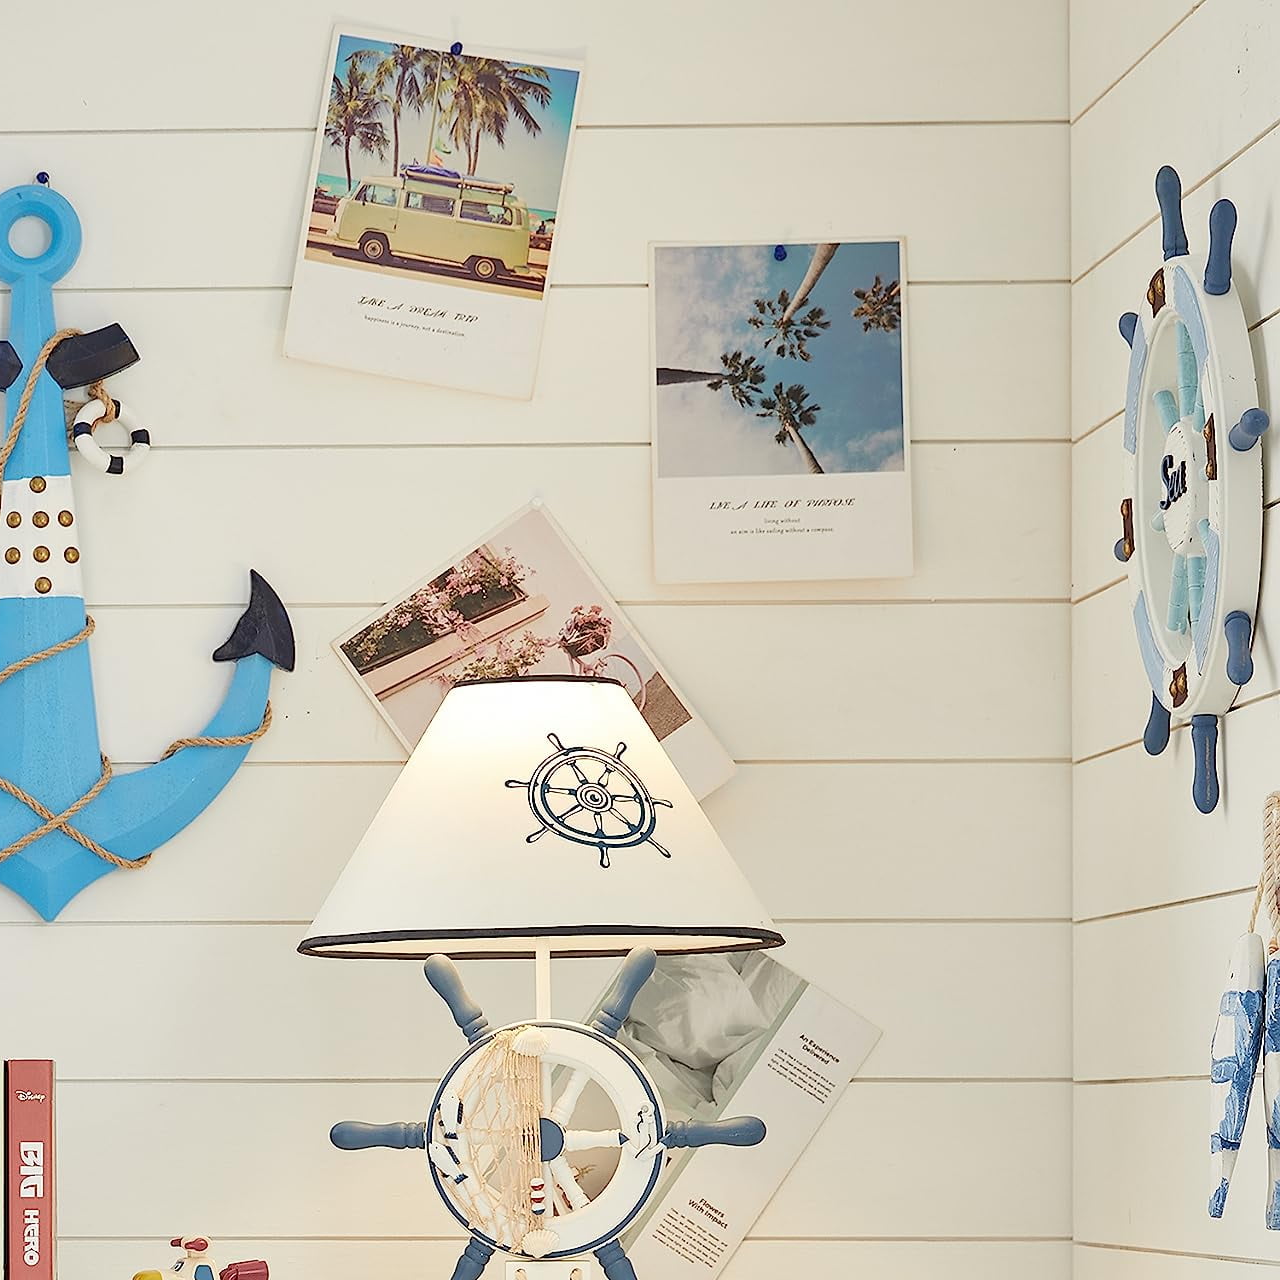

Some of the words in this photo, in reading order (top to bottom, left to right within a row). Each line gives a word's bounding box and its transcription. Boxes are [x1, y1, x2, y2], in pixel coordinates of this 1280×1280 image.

[454, 313, 479, 323] TRIP
[1160, 454, 1187, 510] Sea
[753, 500, 778, 509] LIFE
[784, 499, 802, 508] OF
[800, 1034, 809, 1042] An
[808, 1040, 840, 1063] Experience
[802, 1044, 830, 1064] Delivered
[15, 1090, 46, 1104] Disney
[20, 1142, 44, 1198] BIG
[689, 1199, 705, 1214] With
[704, 1211, 728, 1229] Impact
[699, 1198, 725, 1218] Flowers
